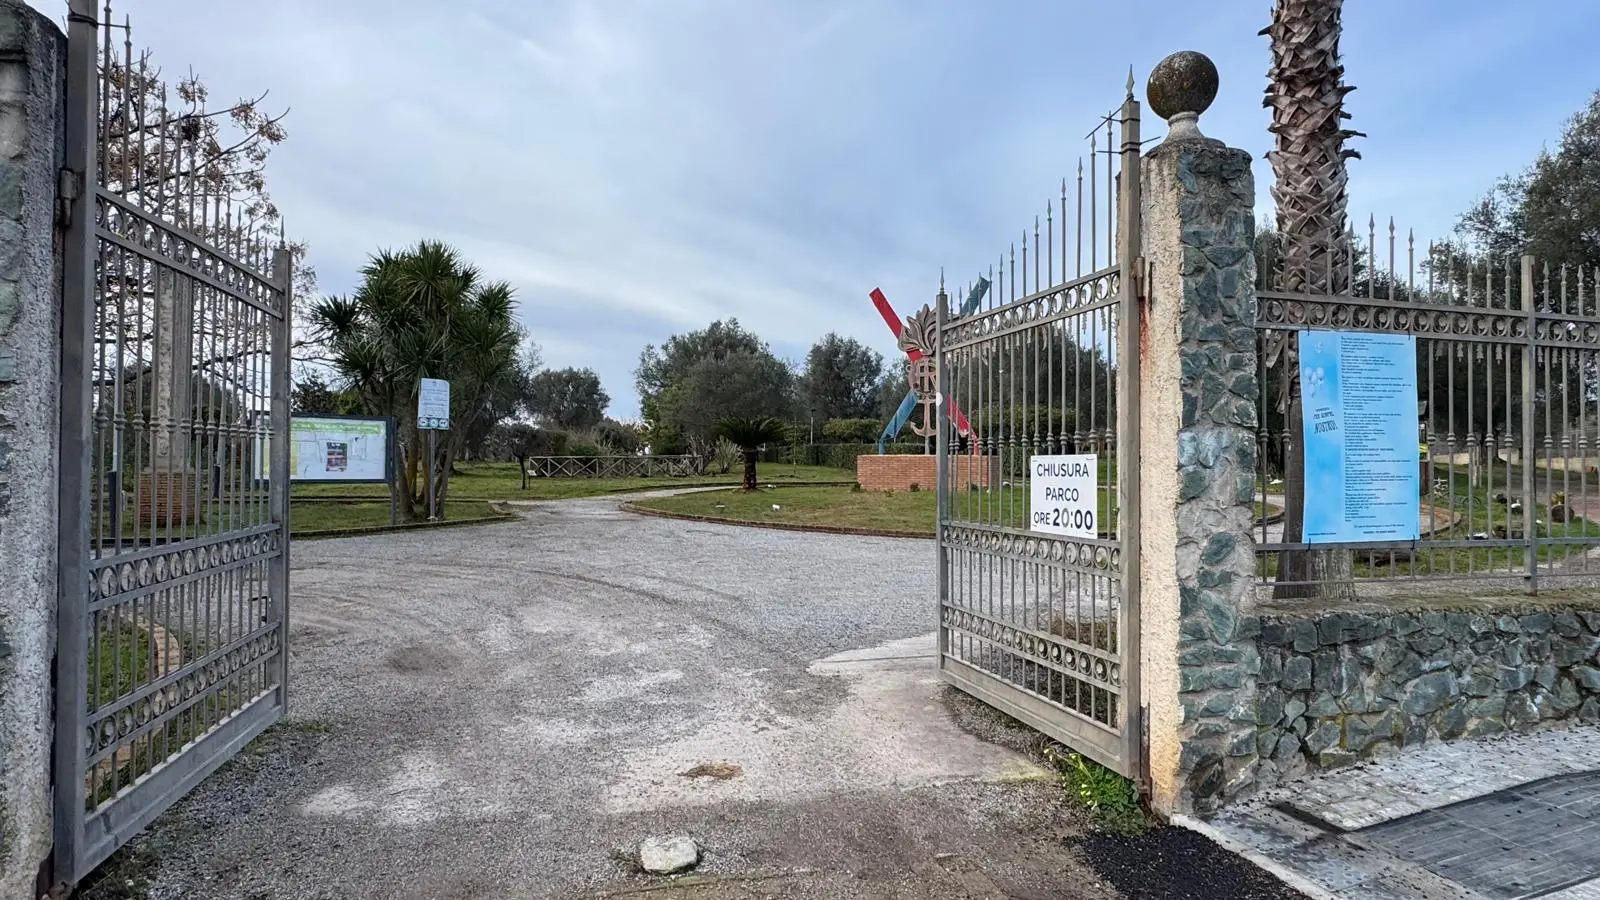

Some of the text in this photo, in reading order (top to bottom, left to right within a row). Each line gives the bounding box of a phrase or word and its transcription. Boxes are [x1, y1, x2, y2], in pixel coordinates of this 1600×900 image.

[1037, 463, 1089, 477] CHIUSURA
[1046, 487, 1079, 502] PARCO
[1034, 508, 1093, 530] ORE 20:00
